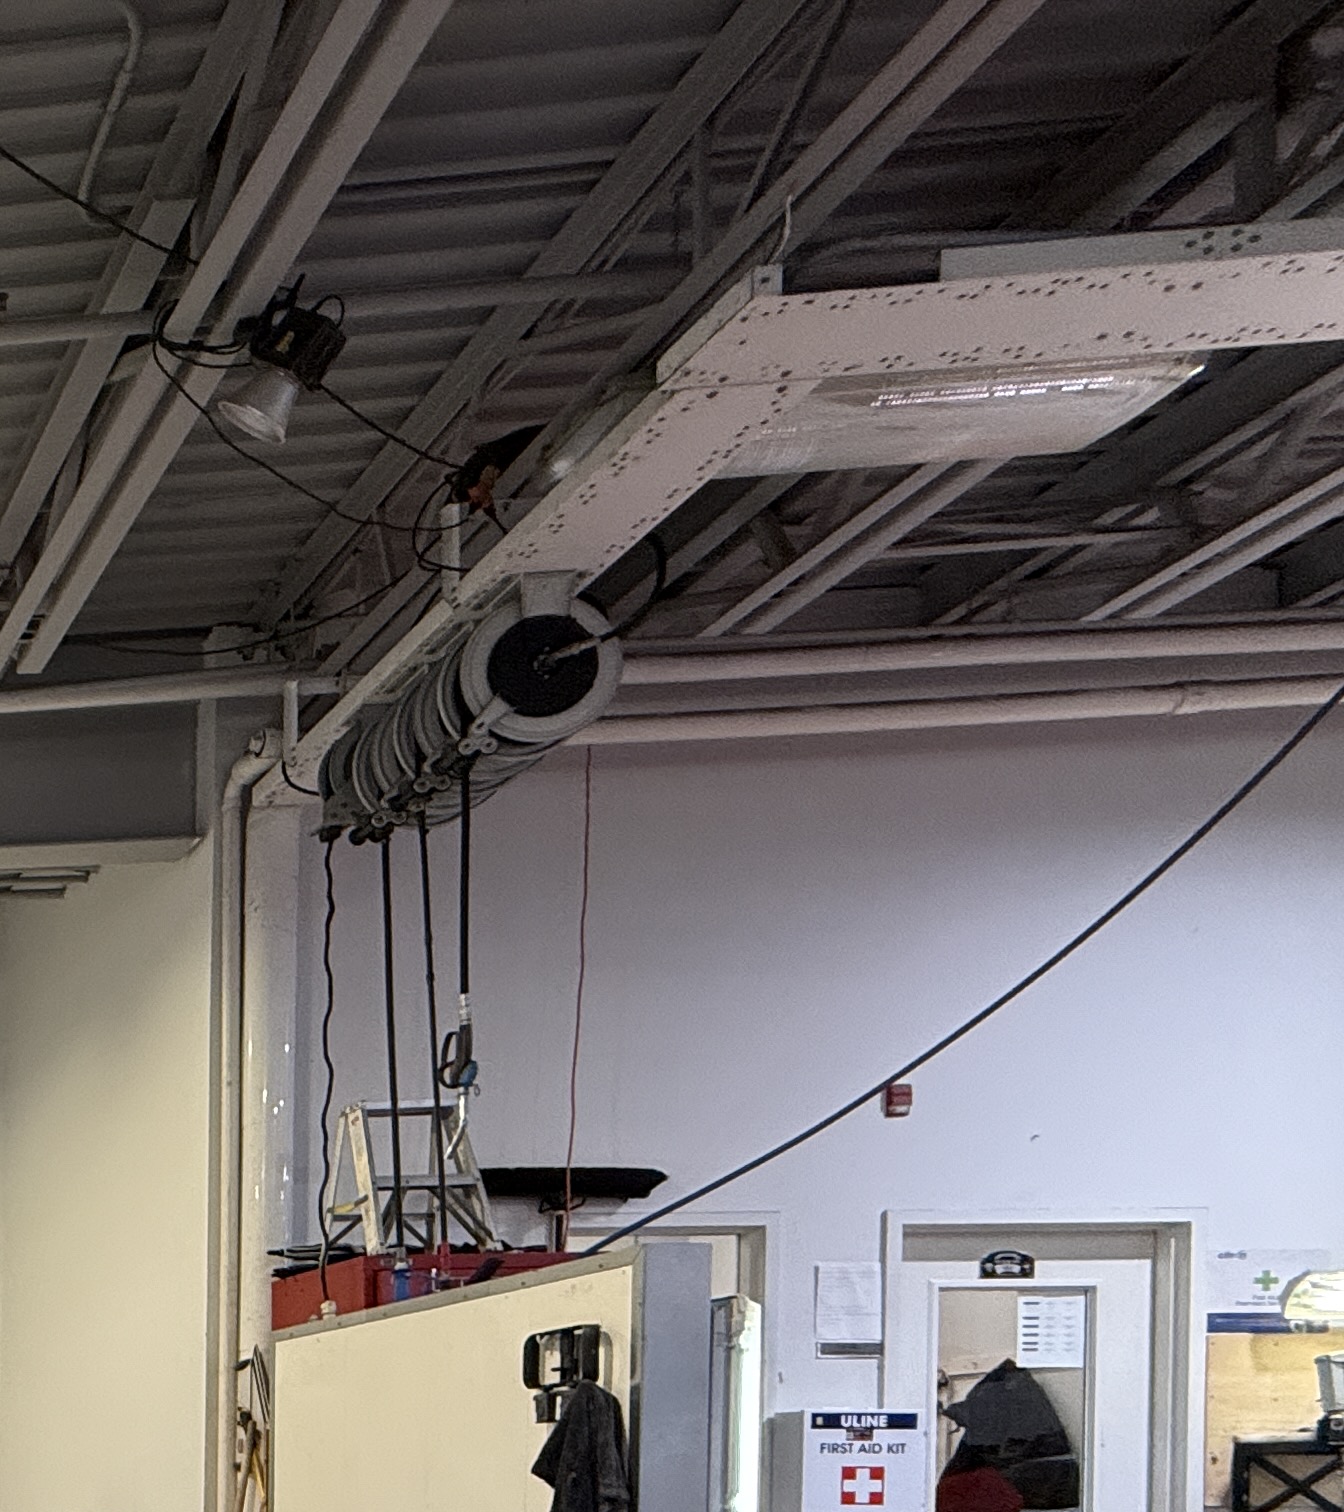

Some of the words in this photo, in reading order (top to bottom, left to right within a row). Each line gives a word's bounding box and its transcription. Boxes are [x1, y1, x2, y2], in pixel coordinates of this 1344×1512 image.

[840, 1415, 889, 1428] ULINE
[820, 1443, 854, 1454] FIRST
[857, 1443, 883, 1454] AID
[887, 1443, 907, 1454] KIT
